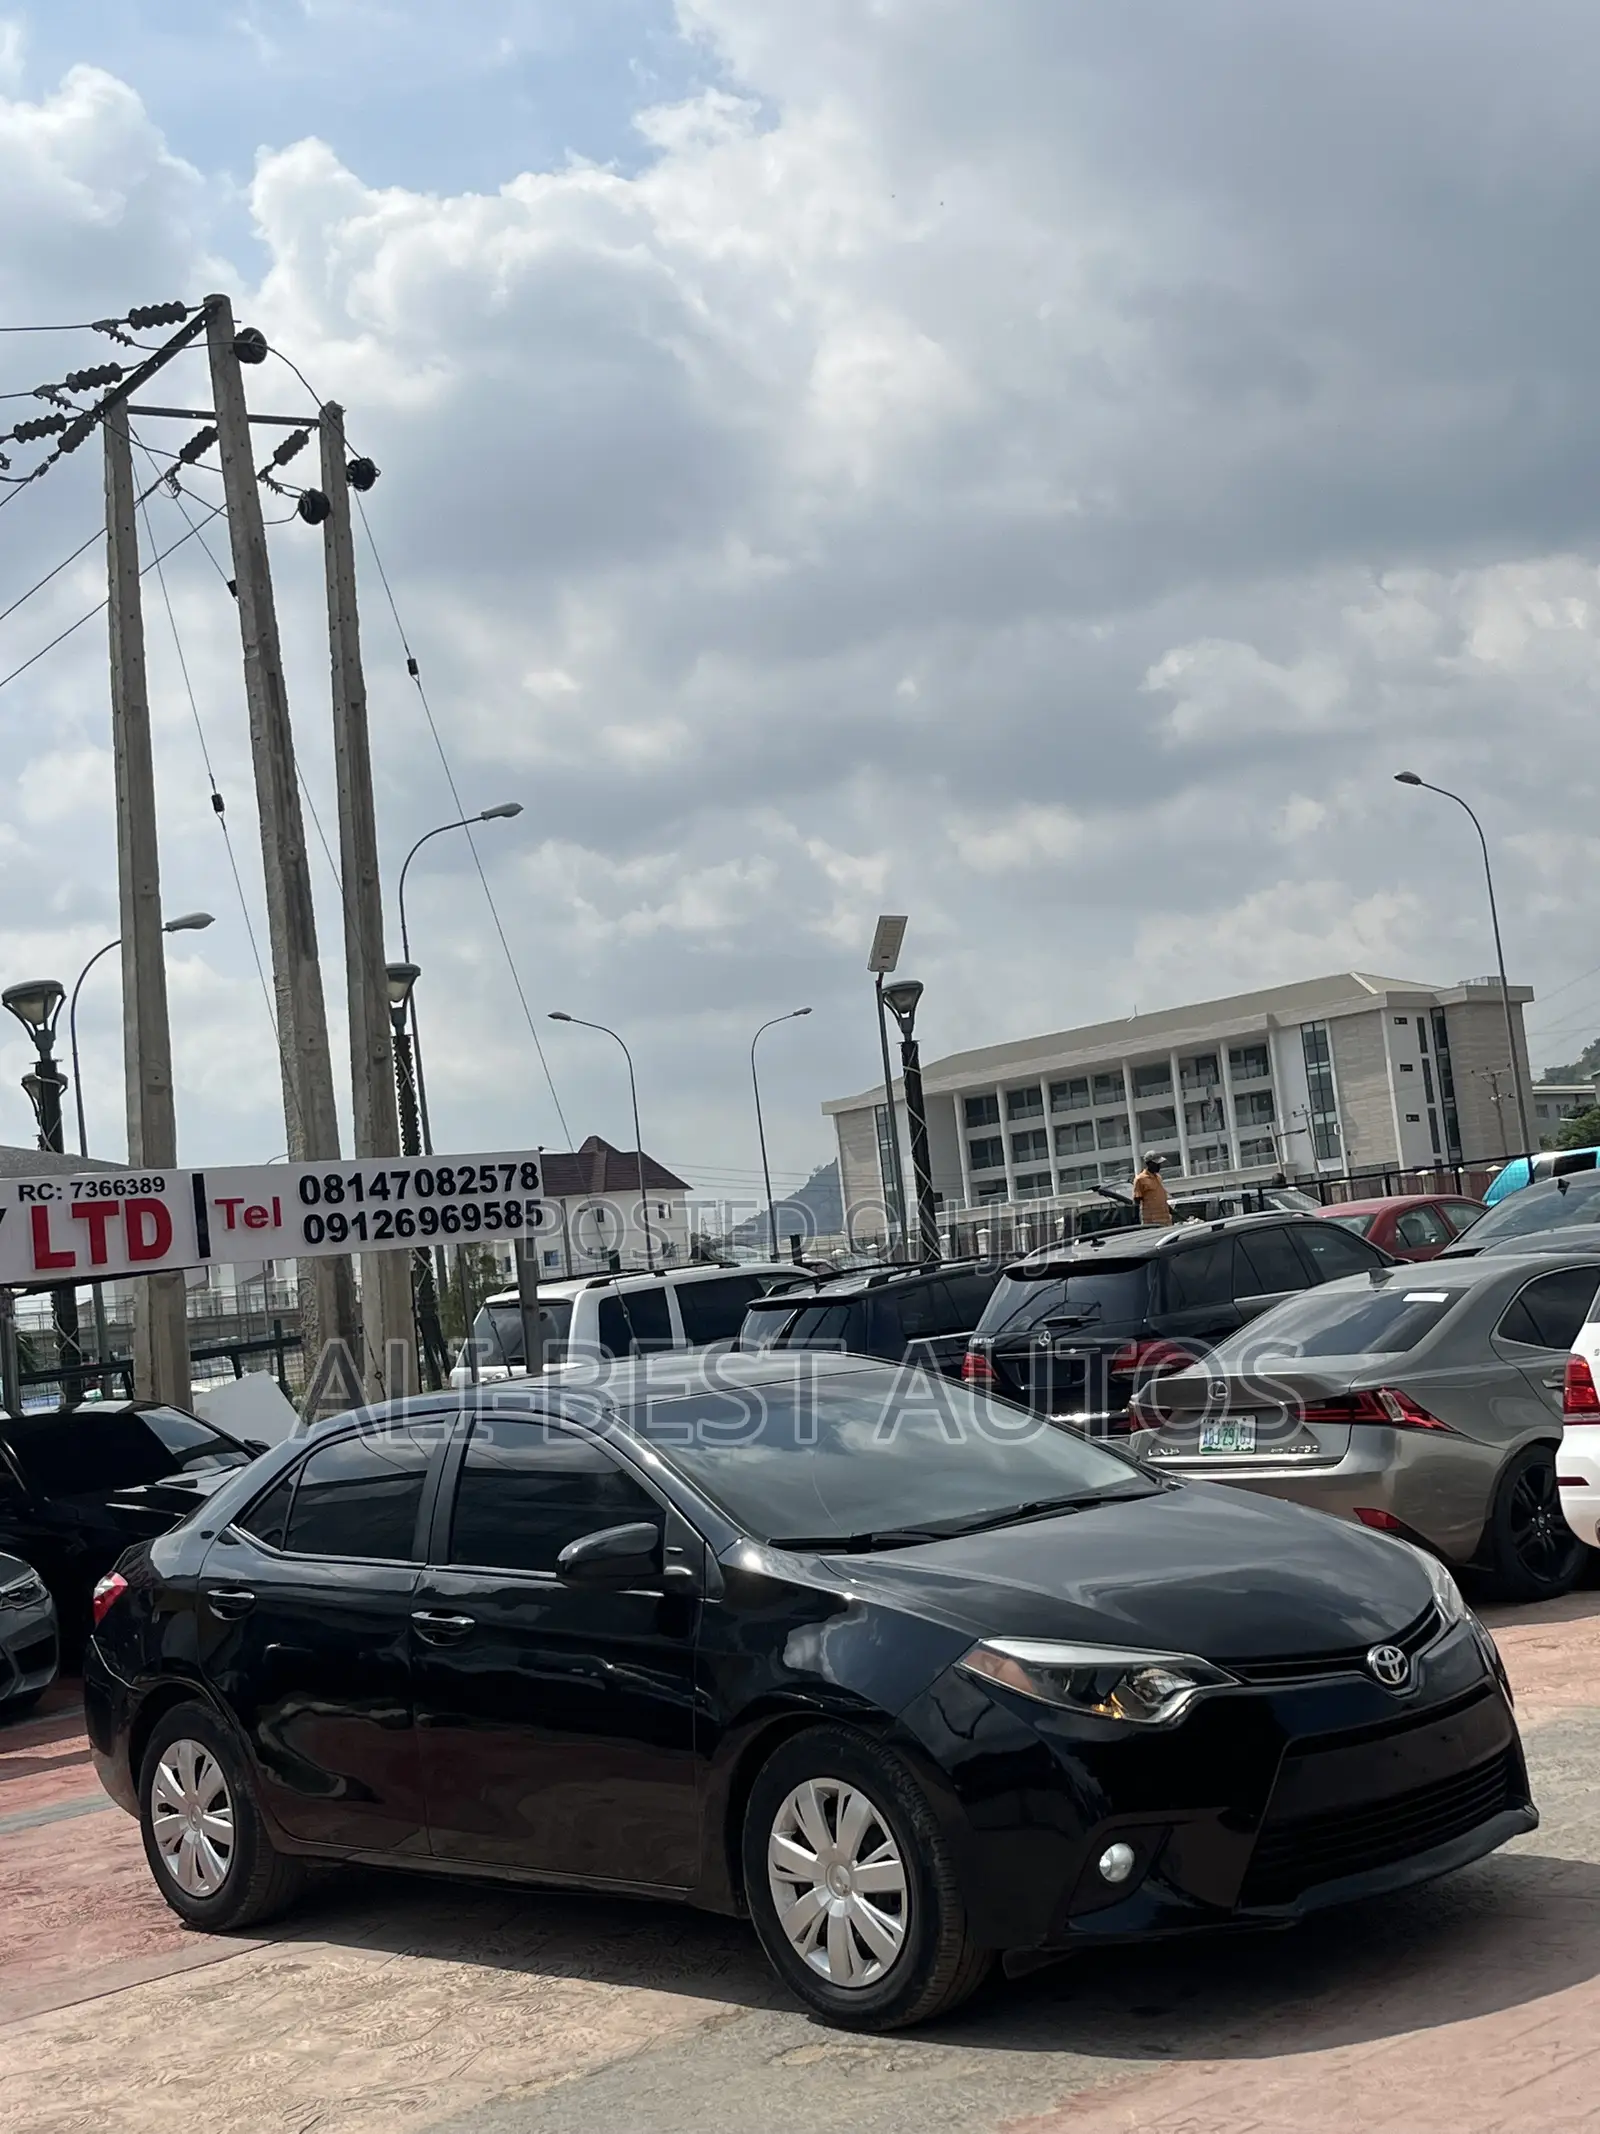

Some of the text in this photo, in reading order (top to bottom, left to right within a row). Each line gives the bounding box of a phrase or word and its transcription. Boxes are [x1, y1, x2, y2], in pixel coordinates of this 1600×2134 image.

[18, 1176, 165, 1201] RC: 7366389
[299, 1162, 539, 1205] 08147082578
[31, 1197, 173, 1270] LTD
[214, 1196, 283, 1230] Tel
[303, 1199, 543, 1244] 09126969585
